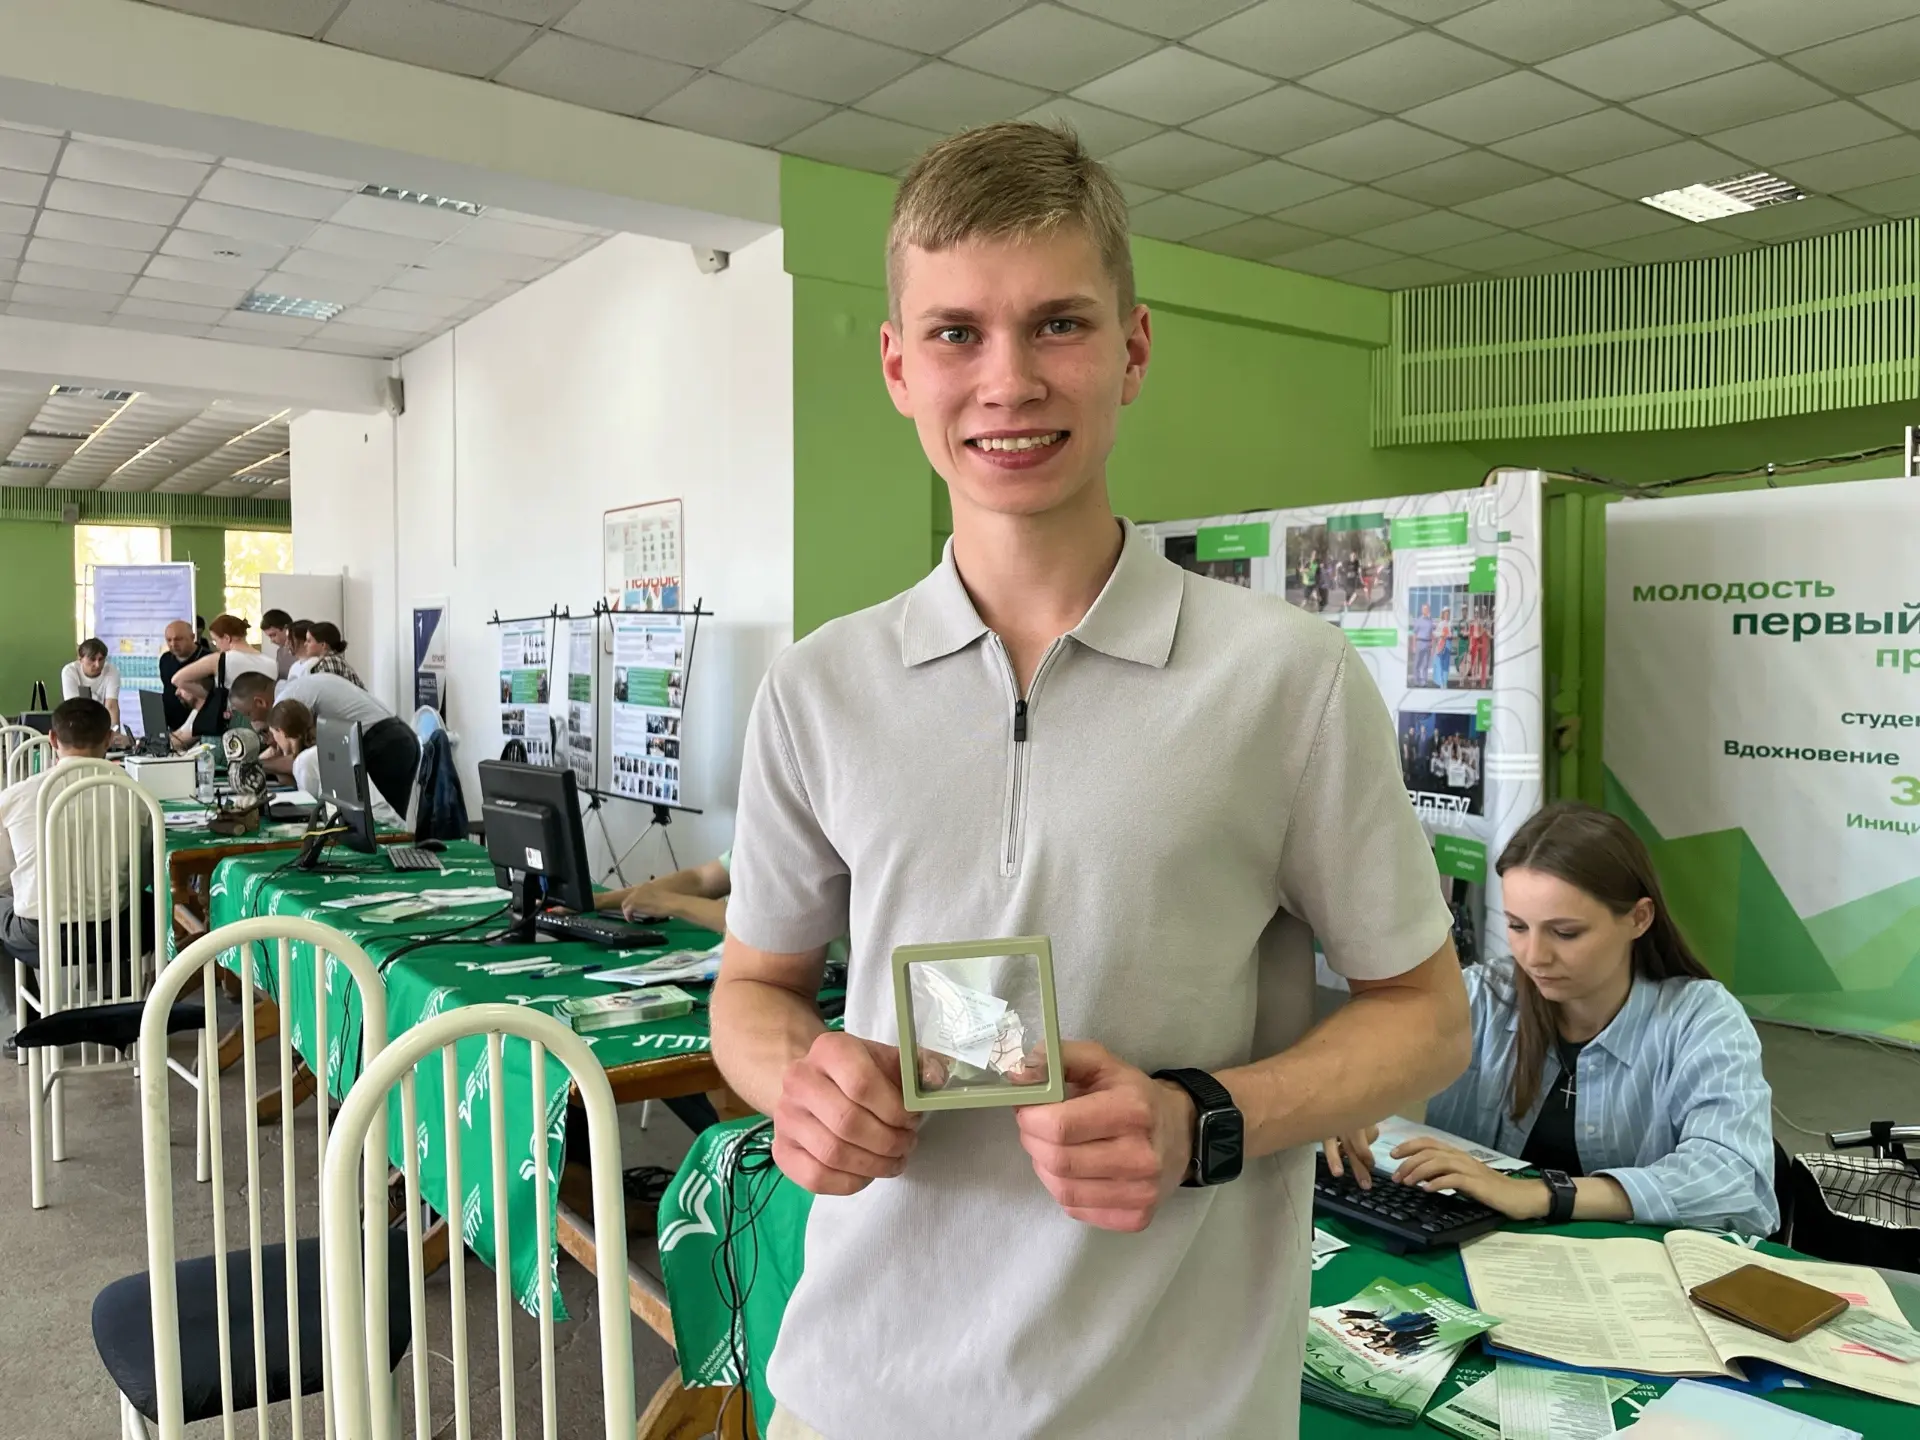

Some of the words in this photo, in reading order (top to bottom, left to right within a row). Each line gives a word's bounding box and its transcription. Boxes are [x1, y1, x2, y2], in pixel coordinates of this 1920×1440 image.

[1632, 579, 1836, 604] молодость
[1732, 601, 1920, 642] первый
[1723, 740, 1900, 766] Вдохновение
[631, 1033, 712, 1049] УГЛТ
